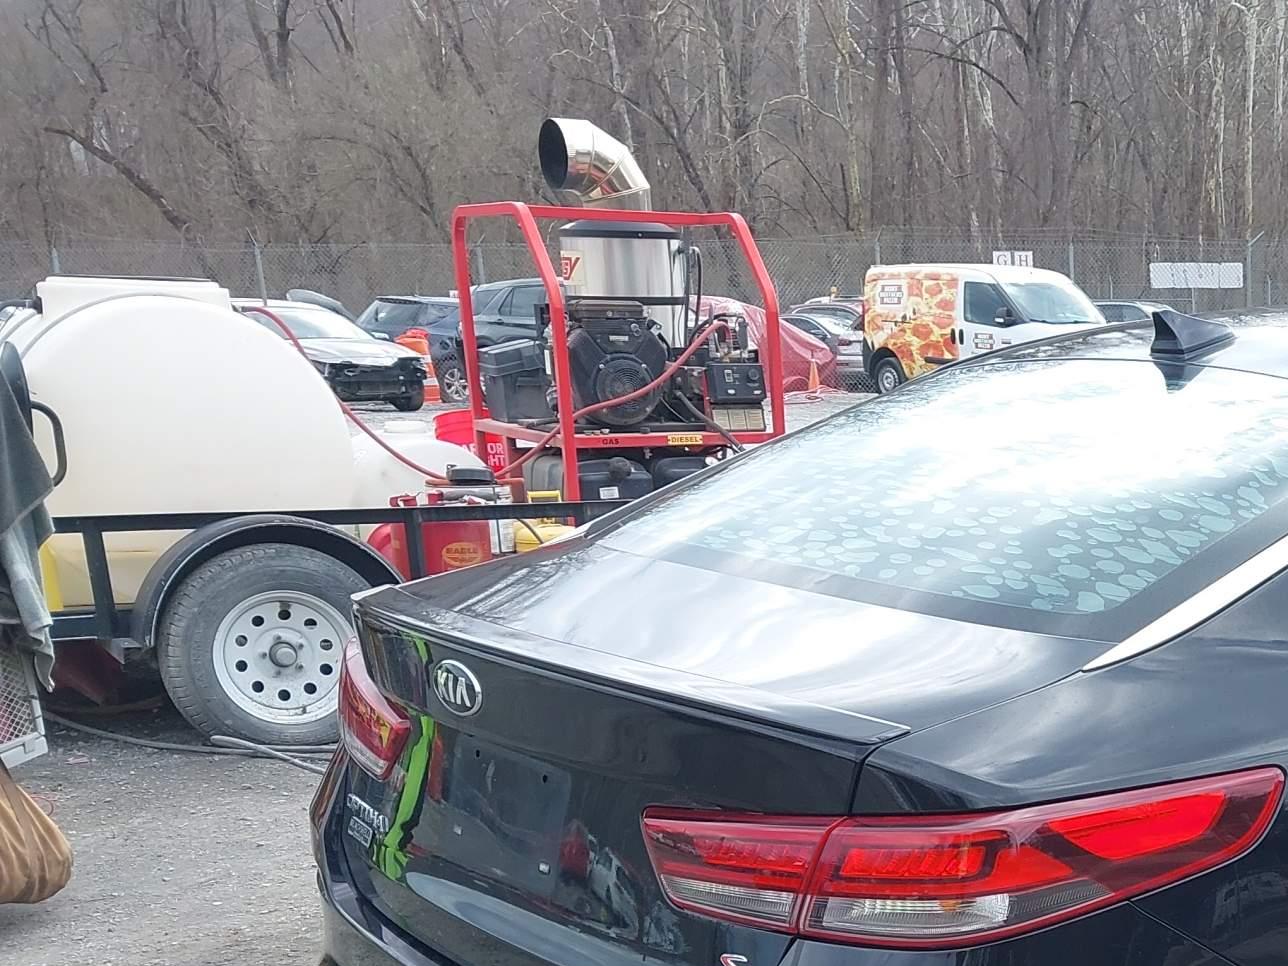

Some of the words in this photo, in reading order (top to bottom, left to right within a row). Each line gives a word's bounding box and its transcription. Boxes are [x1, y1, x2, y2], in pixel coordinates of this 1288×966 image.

[996, 254, 1007, 266] G
[1017, 254, 1029, 267] H
[436, 668, 472, 708] KIA
